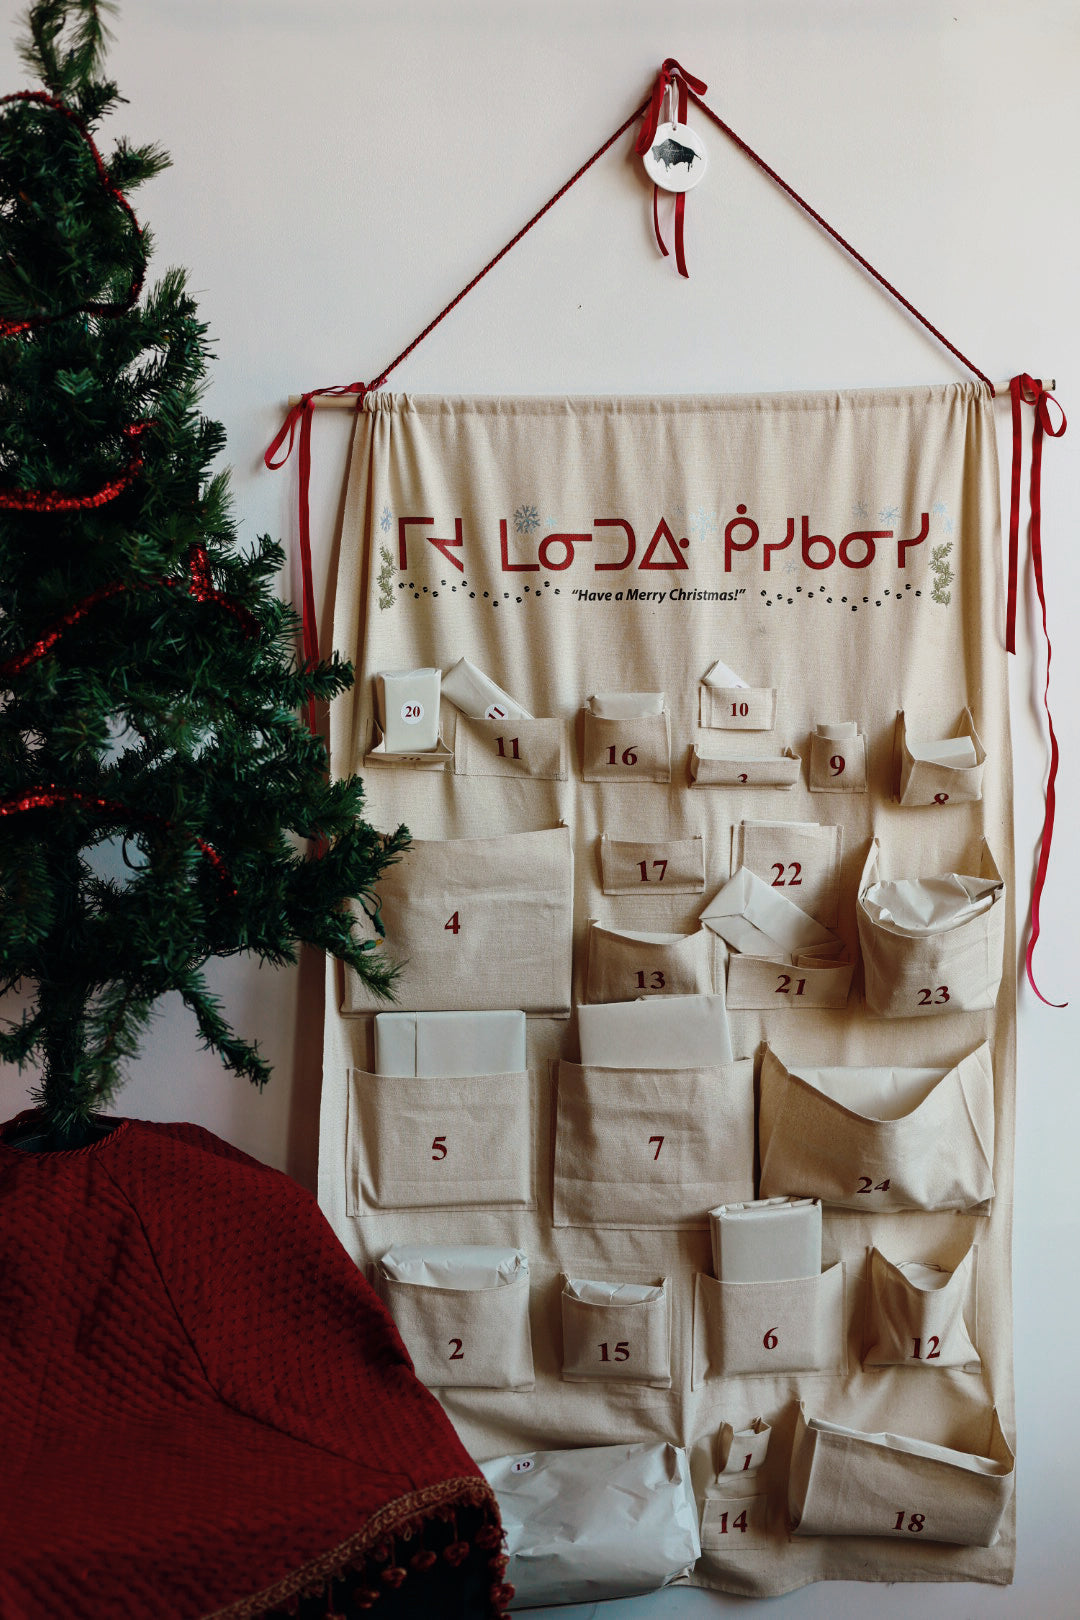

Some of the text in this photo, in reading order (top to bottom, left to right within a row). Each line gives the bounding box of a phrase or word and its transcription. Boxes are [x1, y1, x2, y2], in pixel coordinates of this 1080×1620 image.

[614, 590, 624, 601] a
[626, 588, 667, 604] Merry
[405, 705, 421, 718] 20
[730, 702, 749, 718] 10
[494, 736, 522, 760] 11
[606, 745, 638, 766] 16
[829, 754, 847, 777] 9
[636, 859, 668, 882] 17
[770, 861, 803, 887] 22
[444, 911, 461, 935] 4
[633, 970, 666, 990] 13
[774, 974, 807, 996] 21
[917, 985, 951, 1006] 23
[431, 1136, 448, 1161] 5
[648, 1136, 665, 1161] 7
[855, 1176, 891, 1194] 24
[448, 1338, 465, 1360] 2
[762, 1326, 779, 1350] 6
[911, 1335, 941, 1360] 12
[597, 1341, 631, 1362] 15
[515, 1461, 531, 1471] 19
[742, 1453, 753, 1471] 1
[718, 1509, 749, 1534] 14
[891, 1511, 926, 1533] 18
